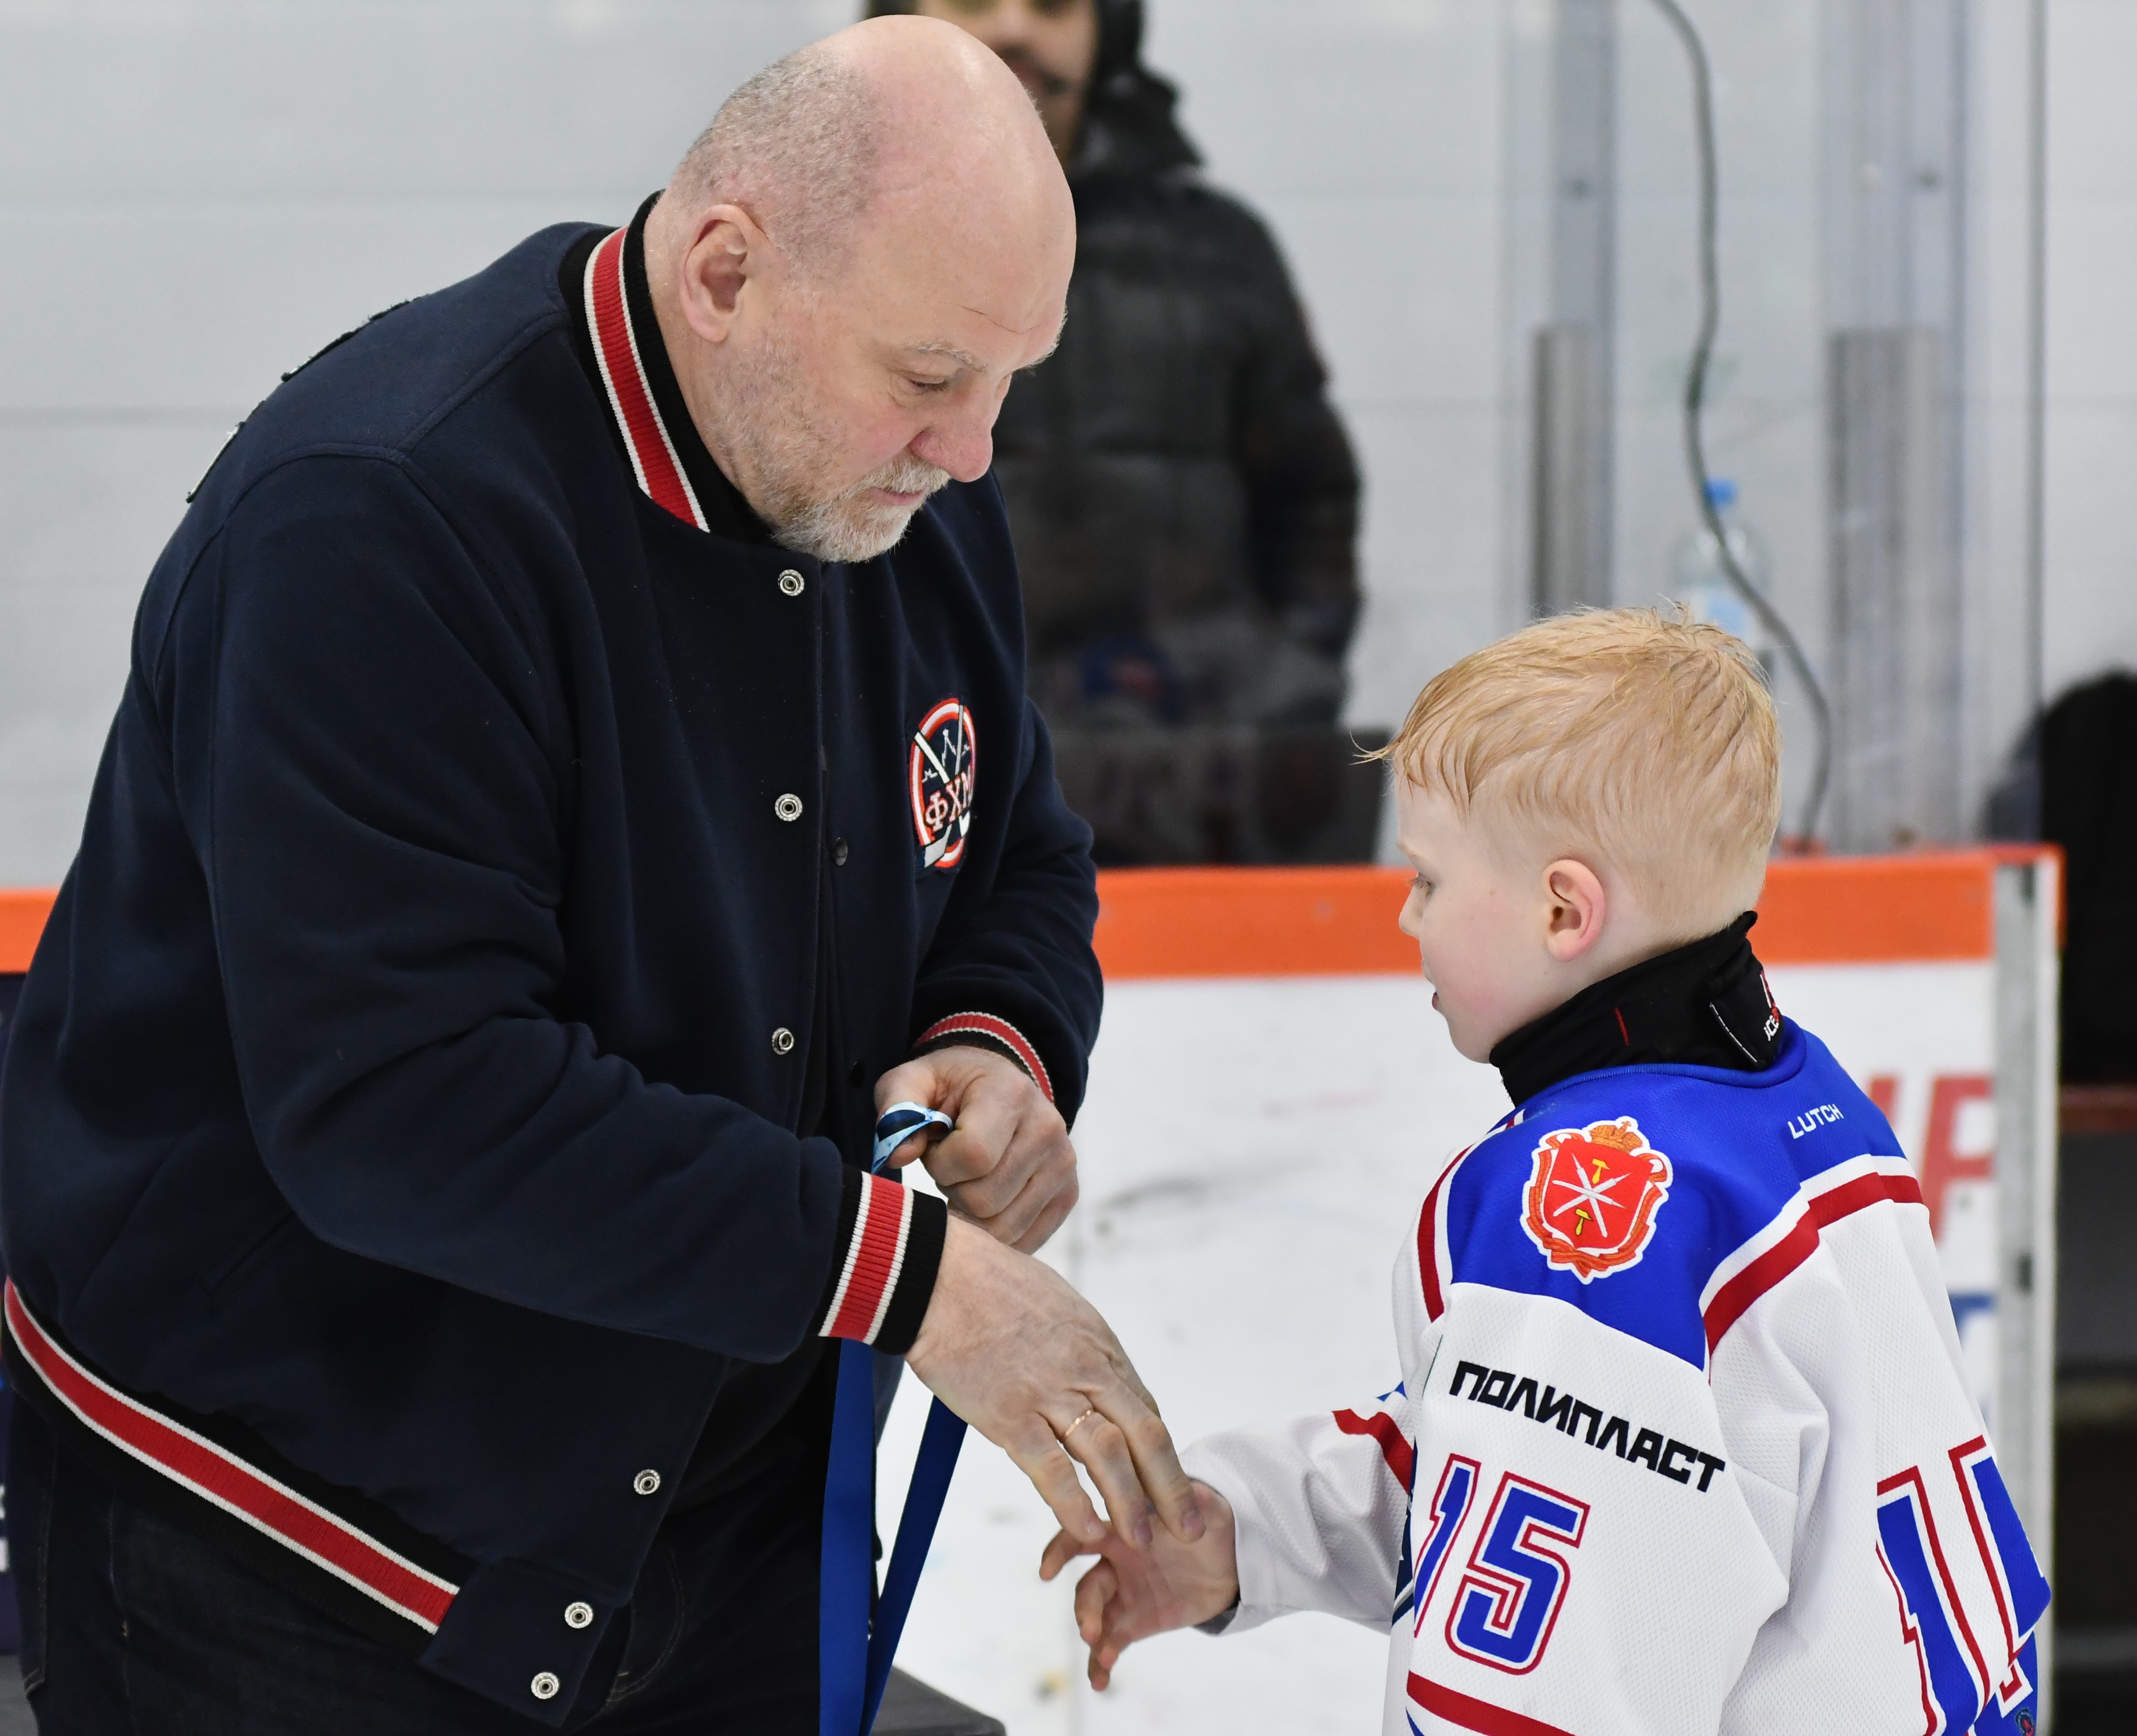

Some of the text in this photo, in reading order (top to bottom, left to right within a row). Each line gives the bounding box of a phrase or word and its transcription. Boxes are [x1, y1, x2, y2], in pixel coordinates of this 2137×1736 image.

[1788, 1104, 1844, 1139] LUTCH
[1449, 1360, 1725, 1492] ПОЛИПЛАСТ
[1413, 1453, 1590, 1675] 15
